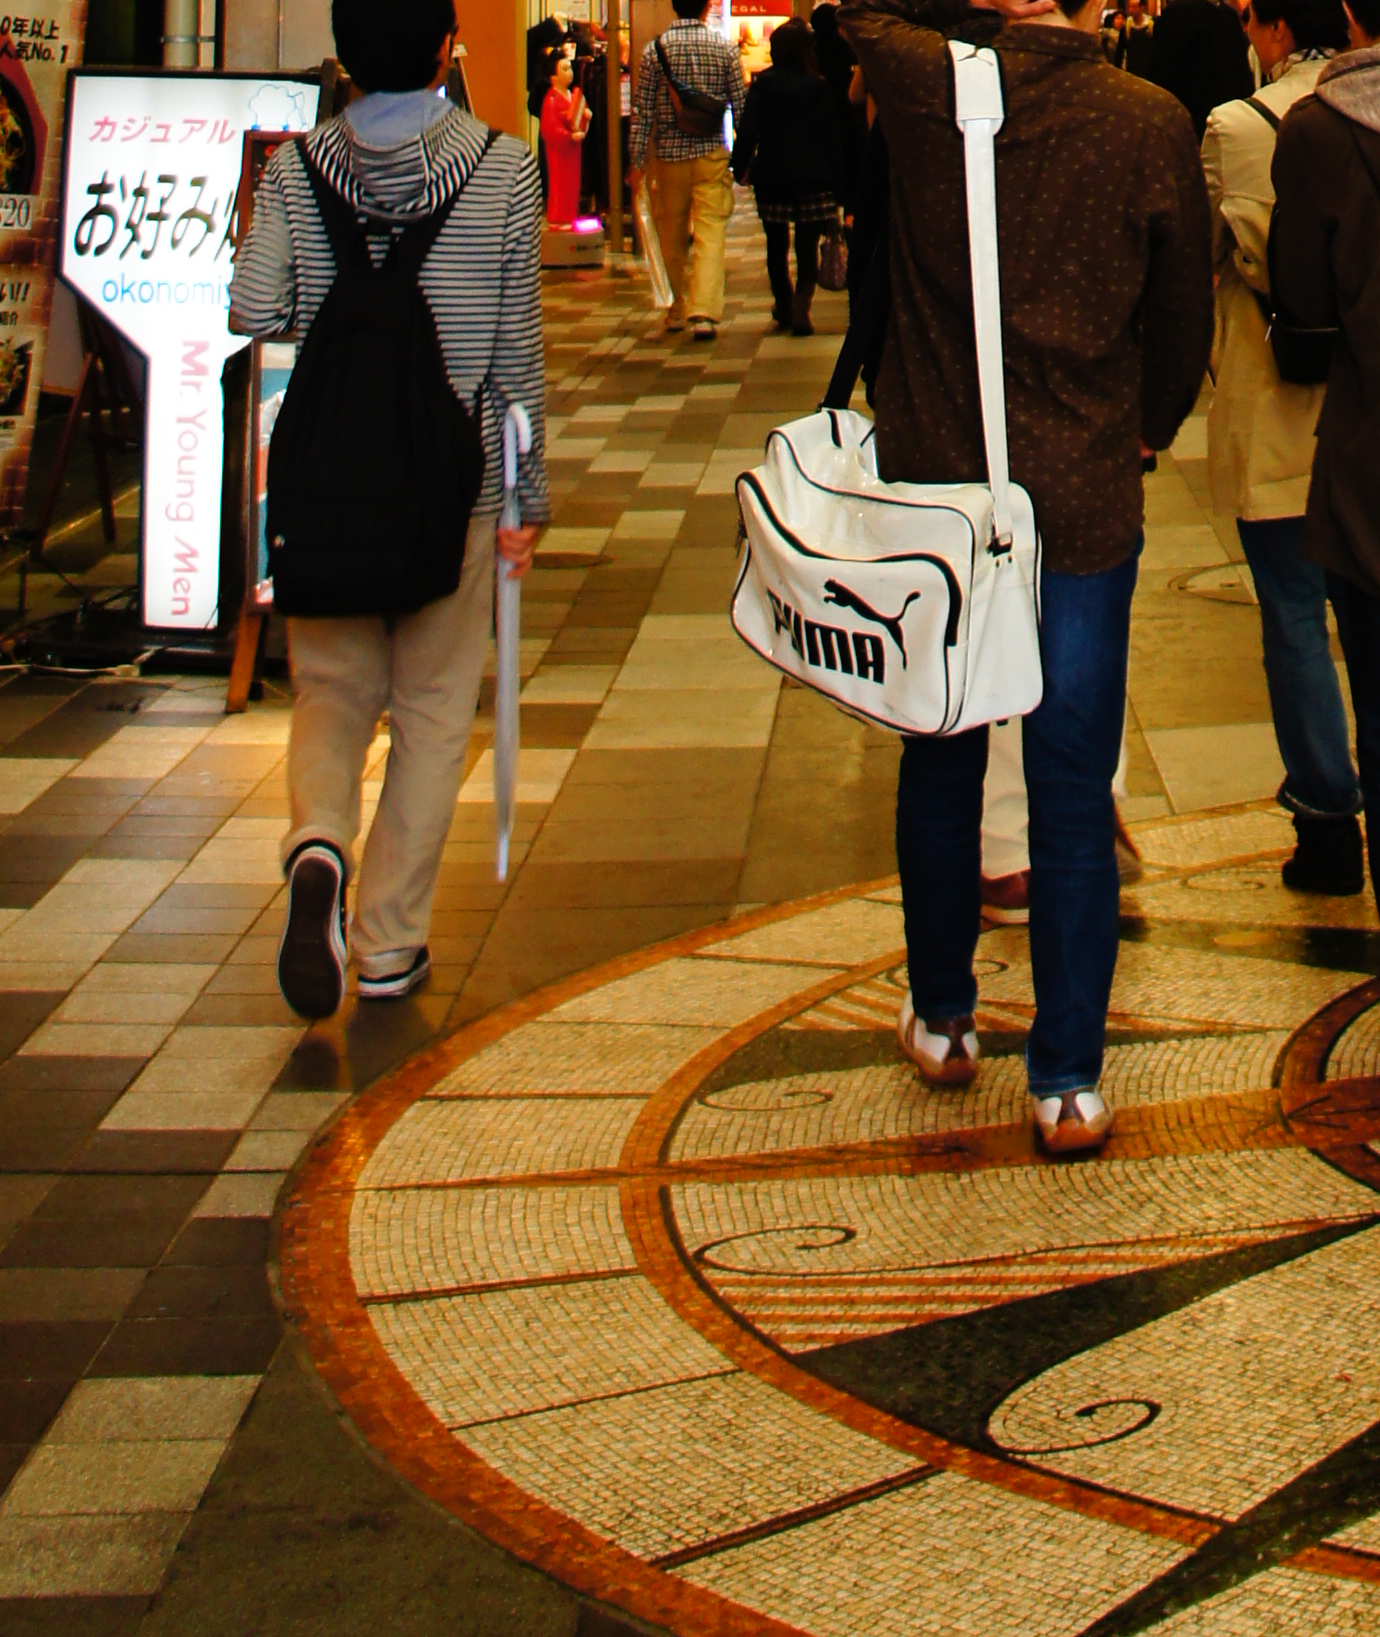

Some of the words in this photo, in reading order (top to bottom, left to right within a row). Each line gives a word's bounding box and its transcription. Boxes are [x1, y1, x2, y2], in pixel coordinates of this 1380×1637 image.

[89, 115, 236, 144] カジュアル
[179, 339, 211, 396] Mr.
[165, 408, 208, 523] Young
[171, 535, 200, 616] Men
